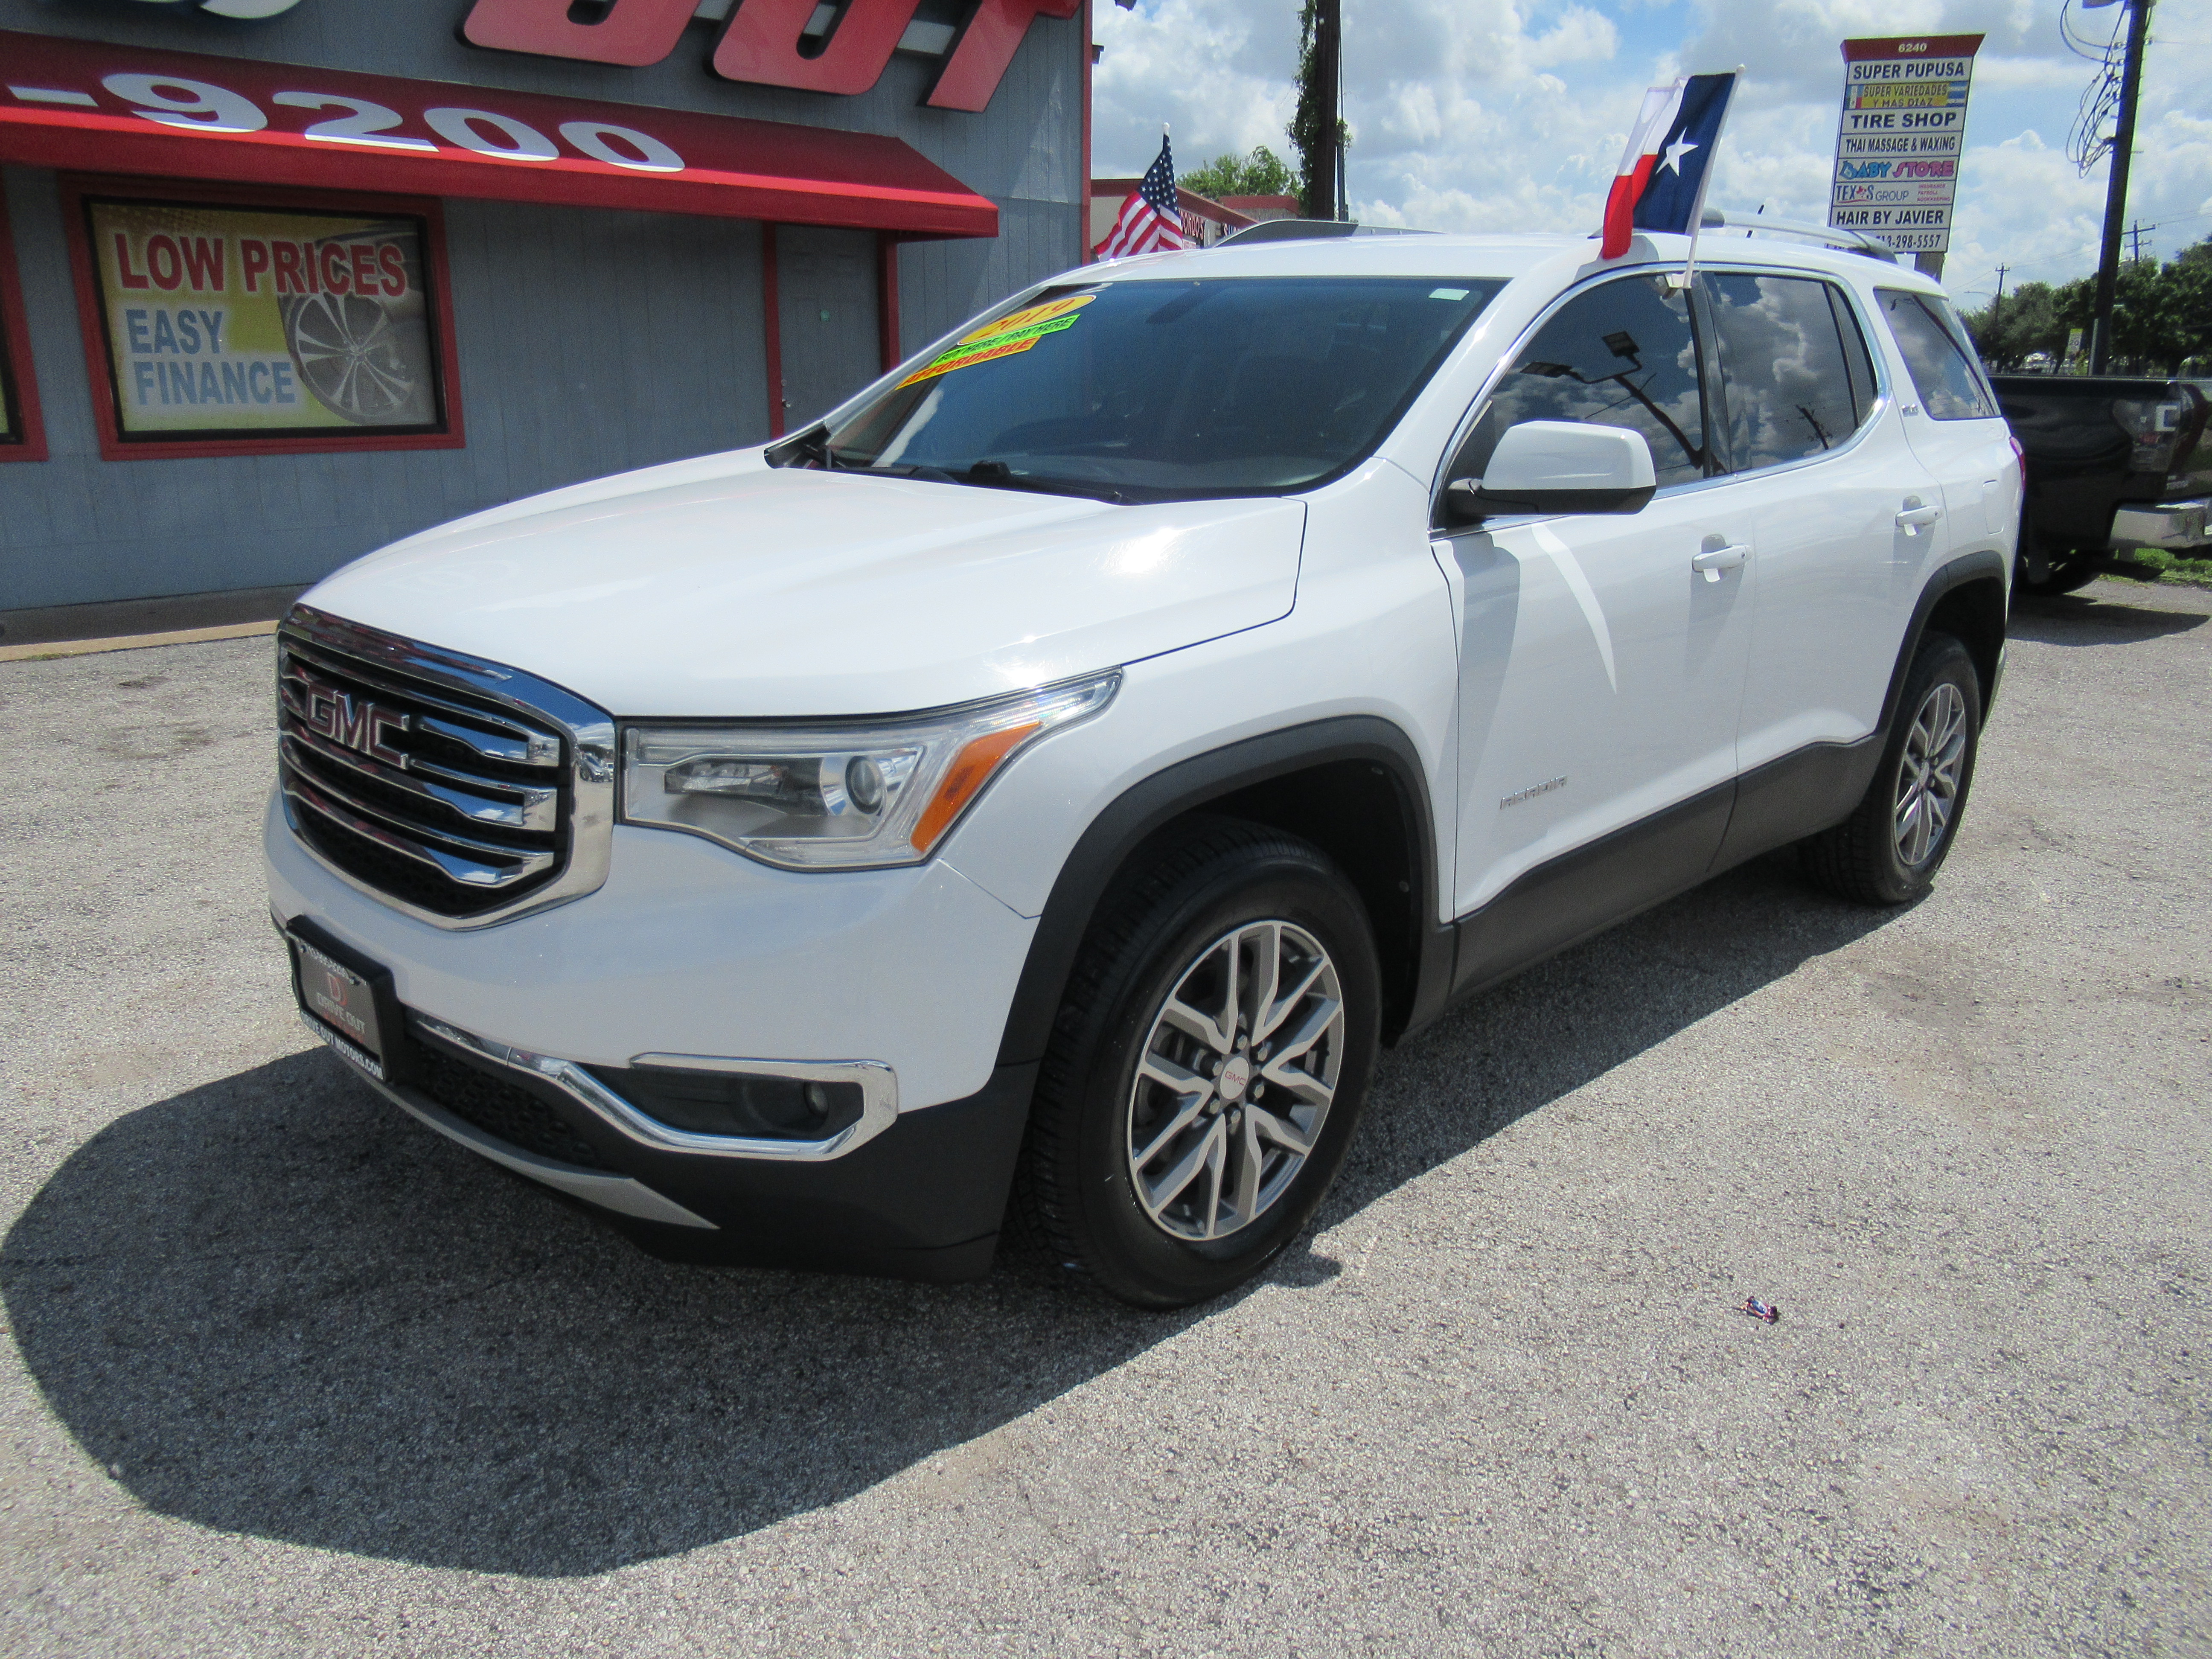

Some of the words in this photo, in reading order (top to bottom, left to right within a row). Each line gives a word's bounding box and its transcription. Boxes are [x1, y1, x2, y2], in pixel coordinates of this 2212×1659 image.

[1898, 43, 1927, 53] 6240
[1853, 64, 1901, 79] SUPER
[1905, 62, 1964, 77] PUPUSA
[1863, 85, 1892, 97] SUPER
[1894, 84, 1947, 96] VARIEDADES
[1883, 99, 1904, 107] MAS
[1908, 98, 1933, 107] DIAZ
[1851, 114, 1896, 128] TIRE
[1902, 112, 1957, 128] SHOP
[1846, 139, 1866, 153] THAI
[1868, 137, 1909, 152] MASSAGE
[1911, 137, 1917, 151] &
[1920, 136, 1956, 151] WAXING
[1839, 160, 1892, 180] BABY
[1893, 160, 1954, 178] STORE
[1875, 191, 1909, 201] GROUP
[1837, 211, 1869, 225] HAIR
[1872, 210, 1892, 224] BY
[1895, 210, 1944, 224] JAVIER
[115, 233, 224, 292] LOW
[240, 239, 407, 297] PRICES
[976, 298, 1076, 341] 2019
[125, 309, 223, 355] EASY
[134, 361, 296, 405] FINANCE
[306, 684, 410, 769] GMC
[346, 1011, 365, 1034] OUT
[1225, 1071, 1247, 1086] GMC
